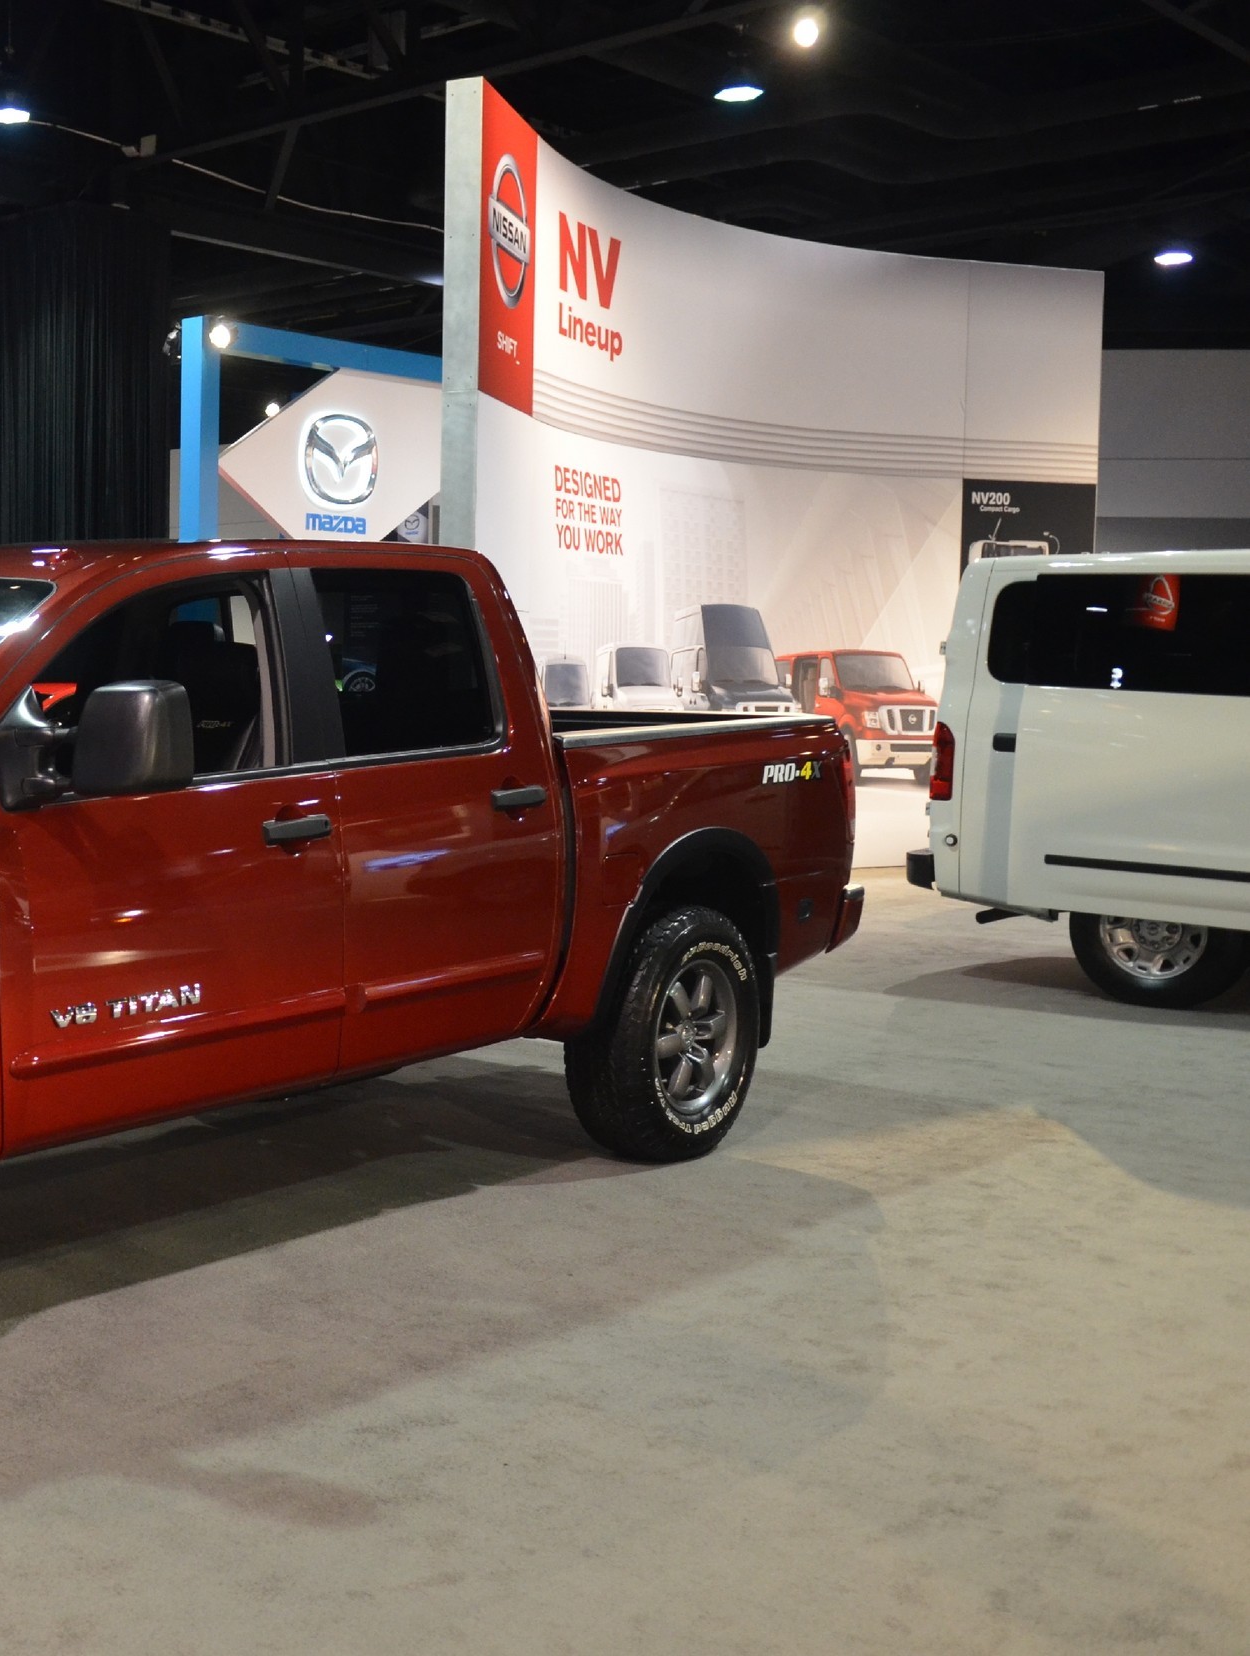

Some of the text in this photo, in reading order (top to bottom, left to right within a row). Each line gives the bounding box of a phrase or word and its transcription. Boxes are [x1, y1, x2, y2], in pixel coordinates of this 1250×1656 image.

[492, 207, 527, 254] NISSAN
[558, 210, 622, 310] NV
[558, 302, 623, 362] Lineup
[554, 464, 621, 503] DESIGNED
[971, 491, 1011, 505] NV200
[555, 497, 622, 527] FOR THE WAY
[980, 504, 1021, 514] Compact Cargo
[556, 523, 623, 556] YOU WORK
[762, 761, 823, 784] PRO-4X
[50, 983, 201, 1028] V8 TITAN
[693, 1090, 738, 1134] Rugged
